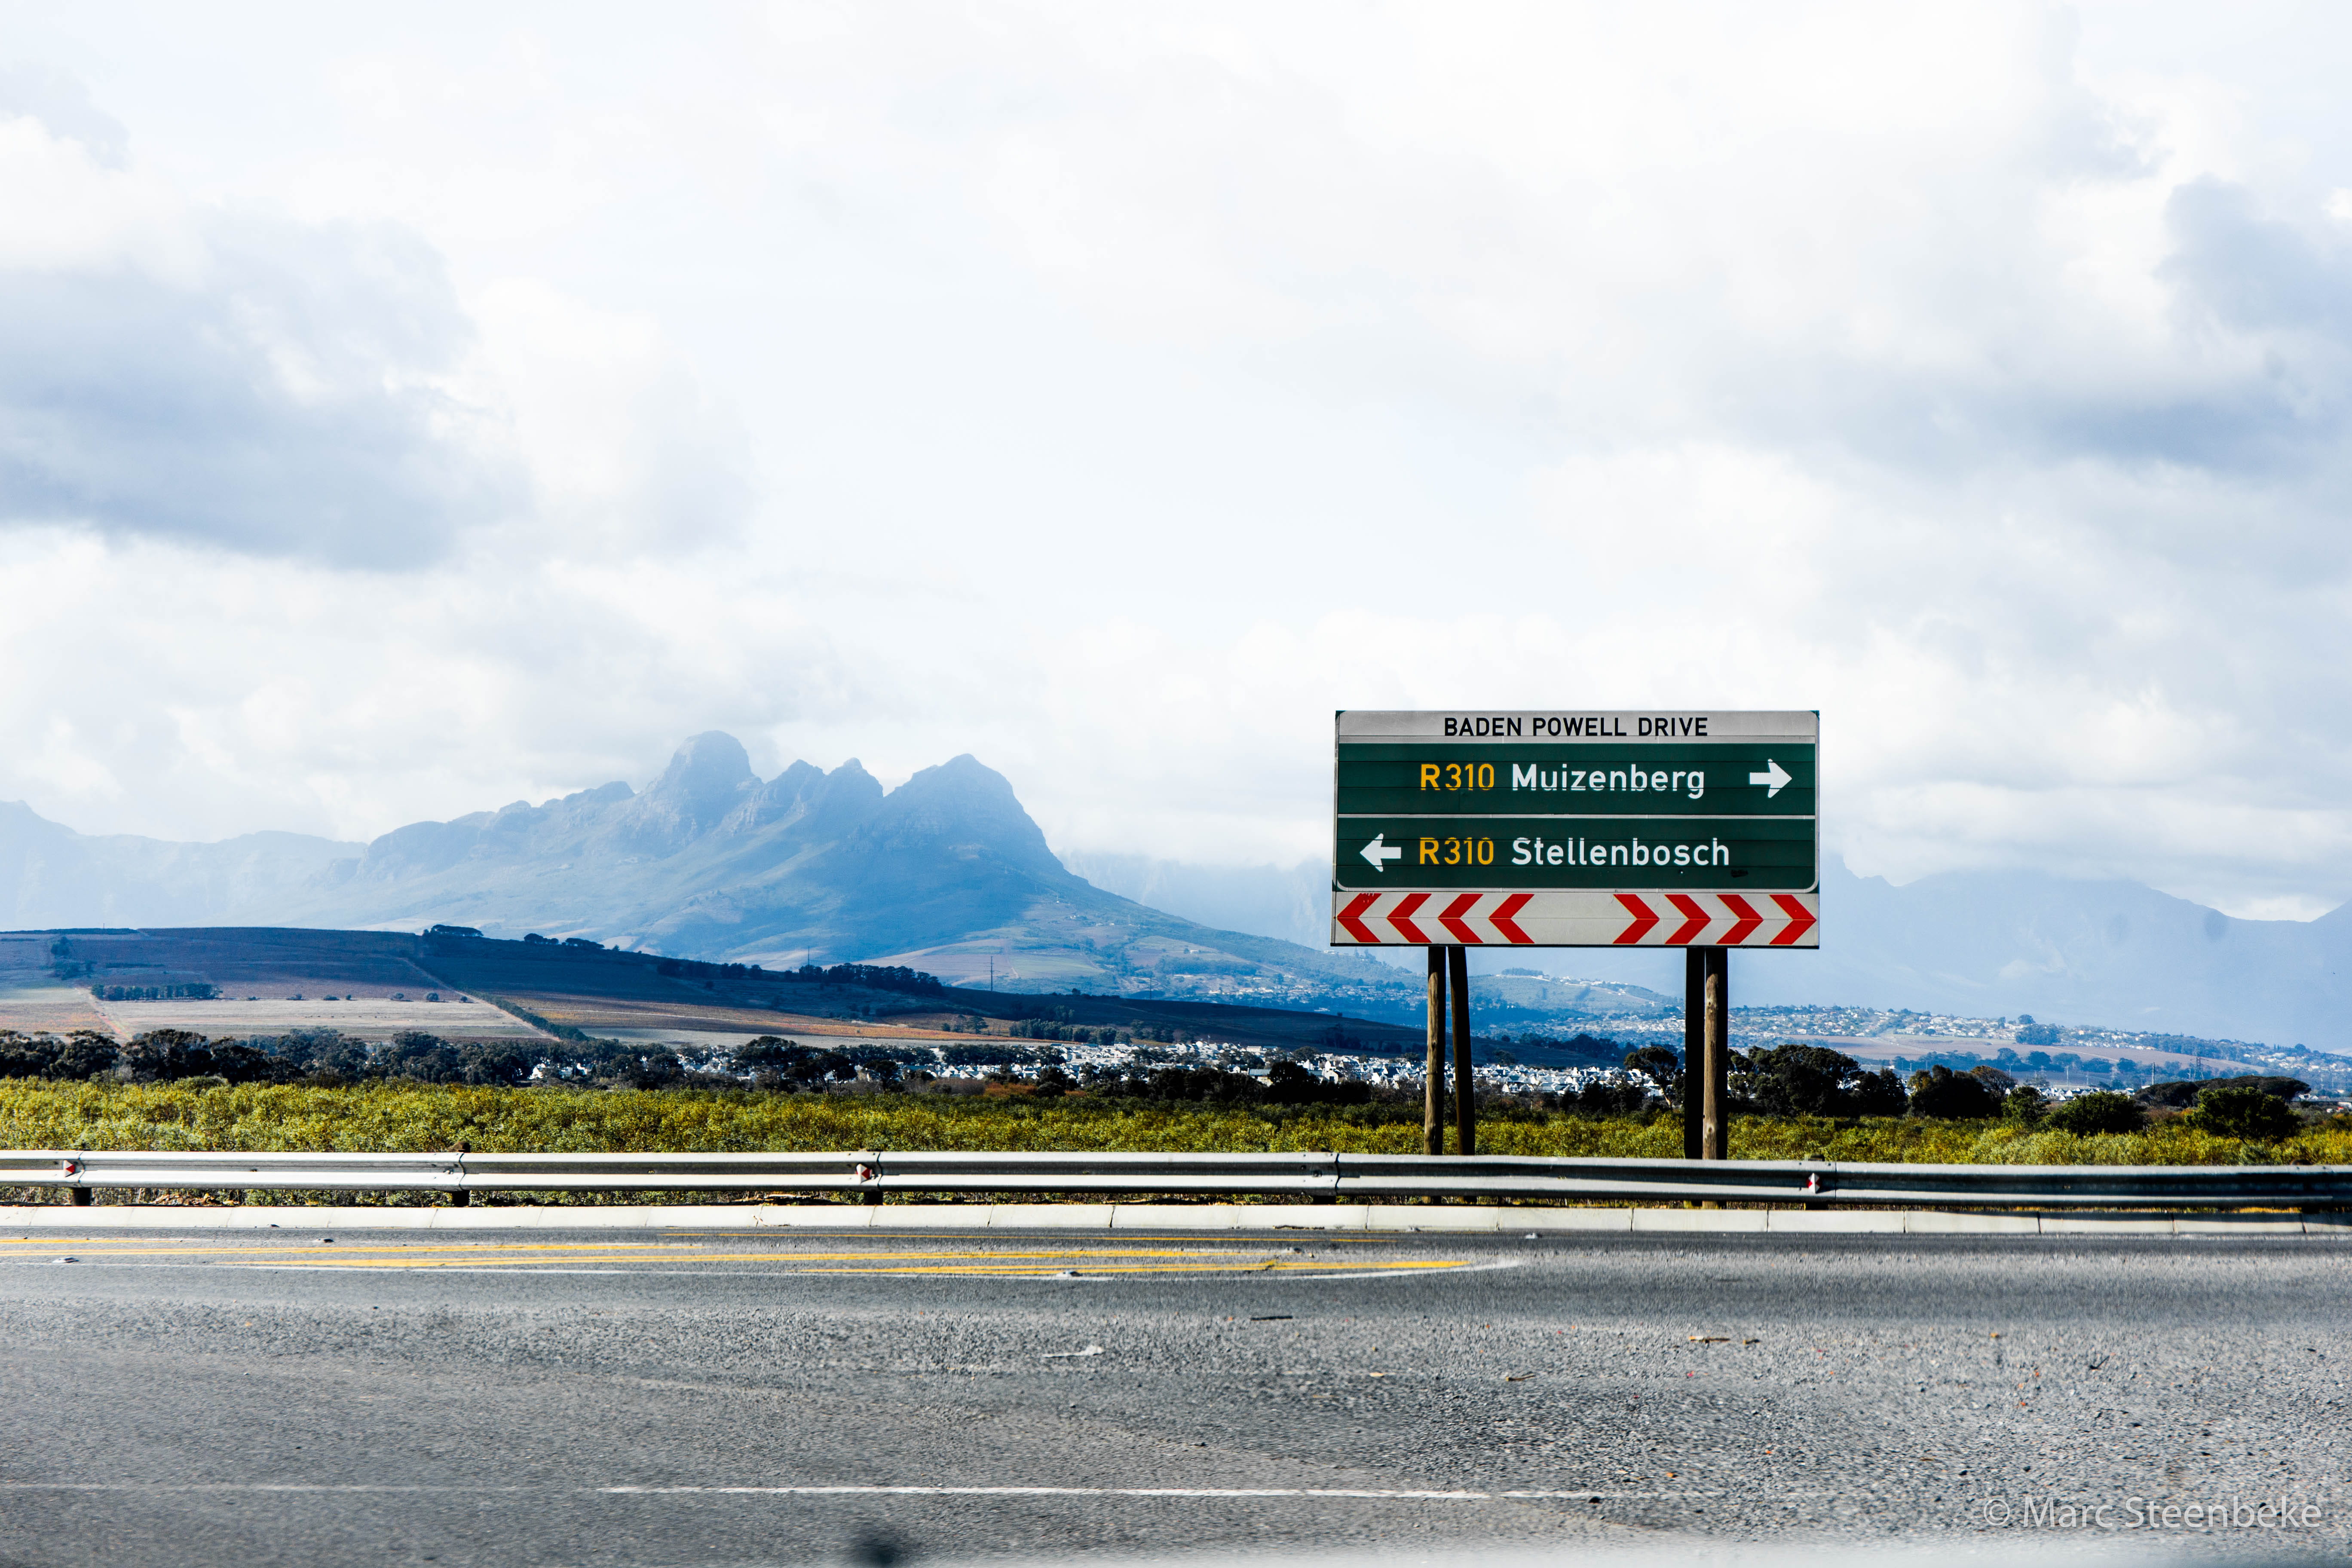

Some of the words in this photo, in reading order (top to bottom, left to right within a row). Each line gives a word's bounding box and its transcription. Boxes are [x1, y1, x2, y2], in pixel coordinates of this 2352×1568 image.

[1445, 717, 1522, 736] BADEN
[1533, 717, 1627, 736] POWELL
[1638, 717, 1708, 736] DRIVE
[1421, 763, 1494, 790] R310
[1513, 763, 1704, 799] Muizenberg
[1420, 837, 1494, 865] R310
[1512, 837, 1729, 865] Stellenbosch
